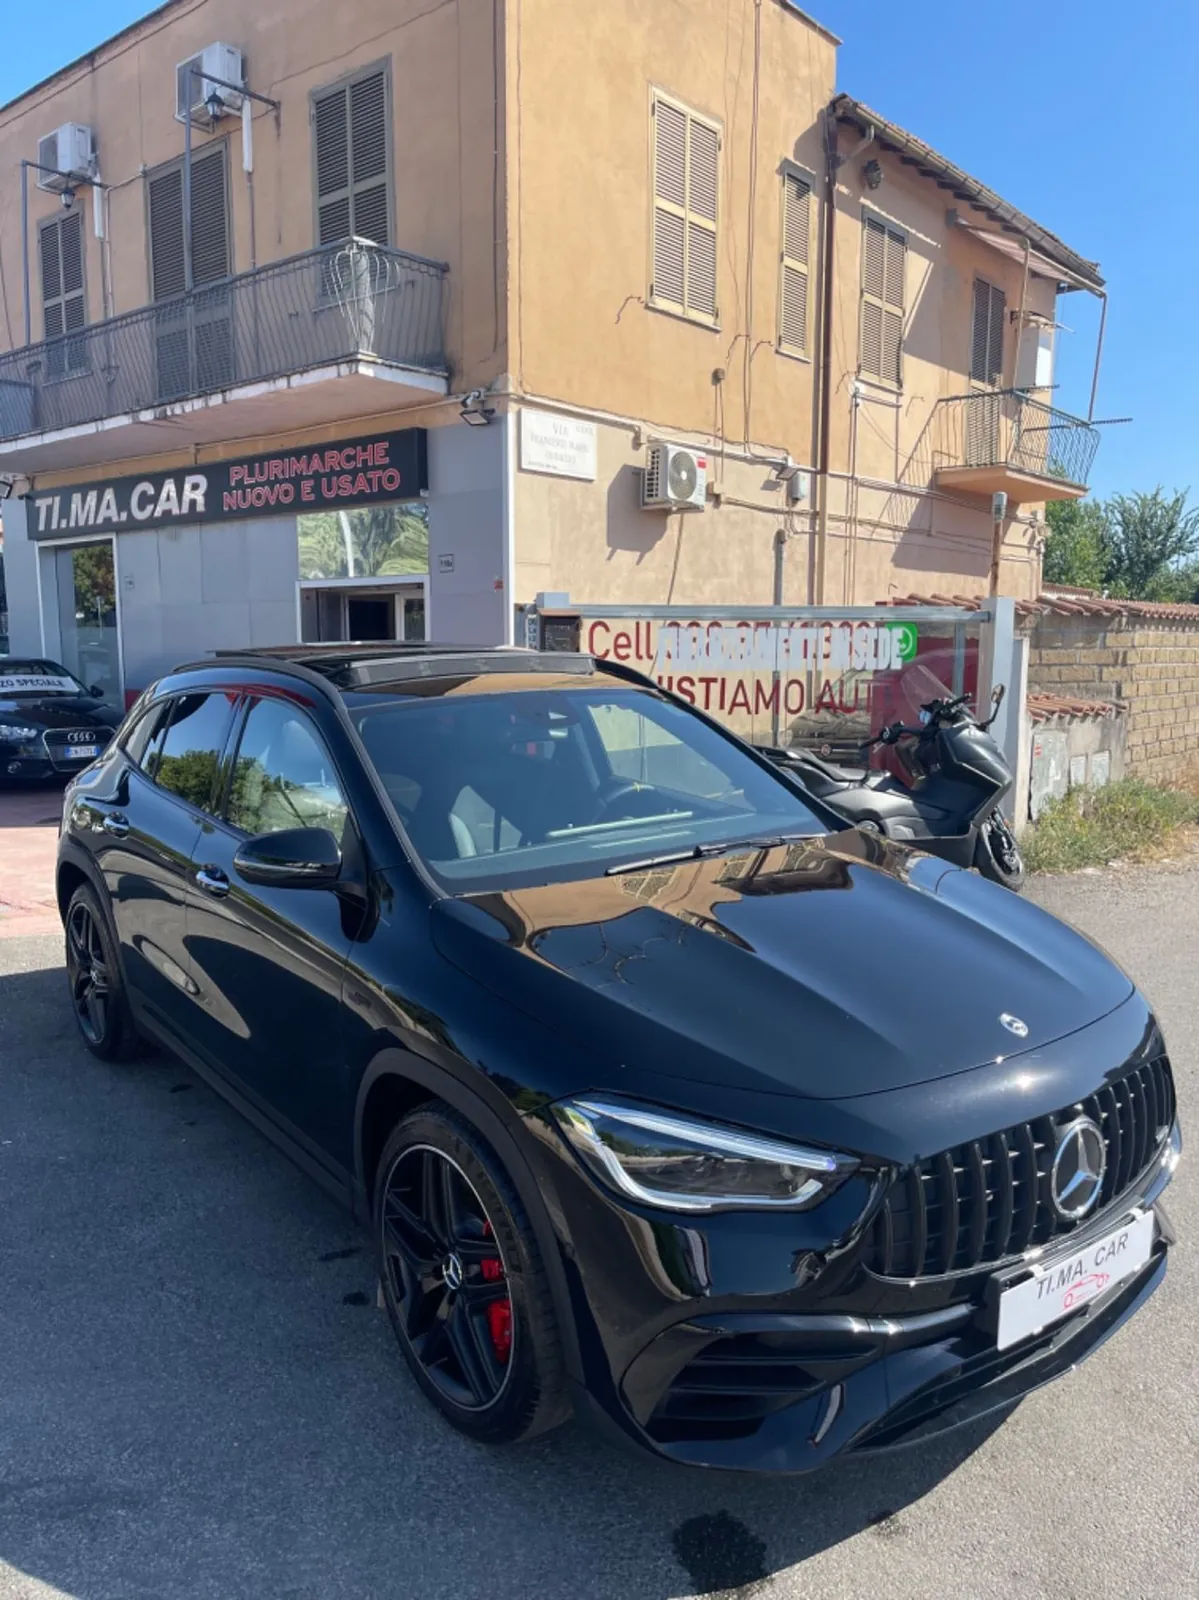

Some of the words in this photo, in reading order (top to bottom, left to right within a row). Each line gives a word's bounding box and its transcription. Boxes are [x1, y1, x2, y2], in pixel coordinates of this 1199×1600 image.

[552, 422, 568, 436] VIA
[229, 442, 389, 486] PLURIMARCHE
[34, 474, 208, 531] TI.MA.CAR
[223, 482, 294, 511] NUOVO
[301, 479, 315, 501] E
[321, 468, 401, 498] USATO
[1094, 1232, 1128, 1266] CAR
